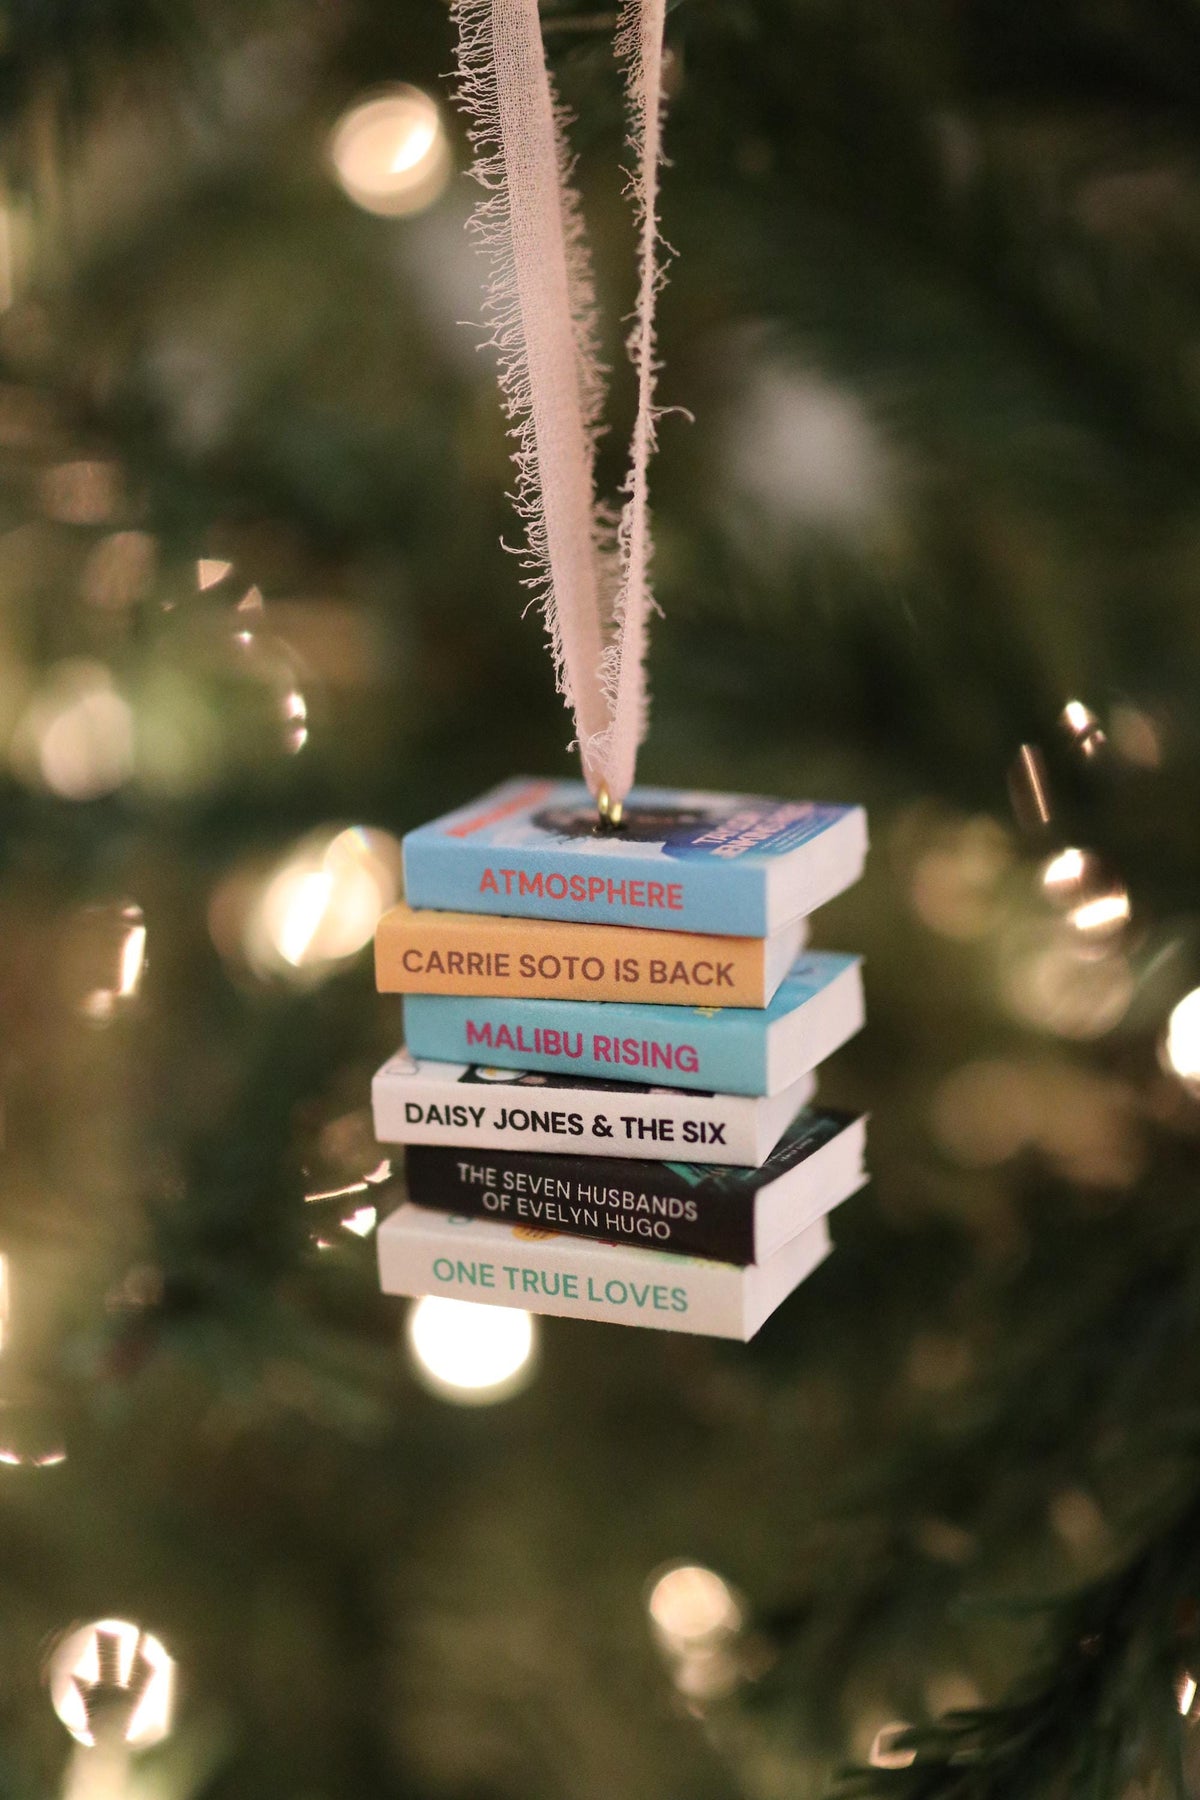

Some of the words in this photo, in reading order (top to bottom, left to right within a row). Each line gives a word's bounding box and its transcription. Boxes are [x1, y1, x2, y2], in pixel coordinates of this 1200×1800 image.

[479, 868, 684, 910] ATMOSPHERE
[402, 949, 510, 977] CARRIE
[519, 954, 605, 982] SOTO
[615, 958, 640, 983] IS
[650, 961, 735, 987] BACK
[466, 1020, 583, 1058] MALIBU
[594, 1035, 699, 1073] RISING
[405, 1102, 485, 1128] DAISY
[494, 1108, 584, 1136] JONES
[592, 1115, 614, 1137] &
[620, 1116, 674, 1141] THE
[682, 1121, 727, 1145] SIX
[457, 1162, 496, 1187] THE
[503, 1171, 570, 1199] SEVEN
[578, 1184, 698, 1222] HUSBANDS
[483, 1192, 510, 1211] OF
[518, 1199, 598, 1227] EVELYN
[606, 1213, 671, 1240] HUGO
[433, 1258, 495, 1288] ONE
[503, 1265, 578, 1299] TRUE
[588, 1277, 688, 1313] LOVES
